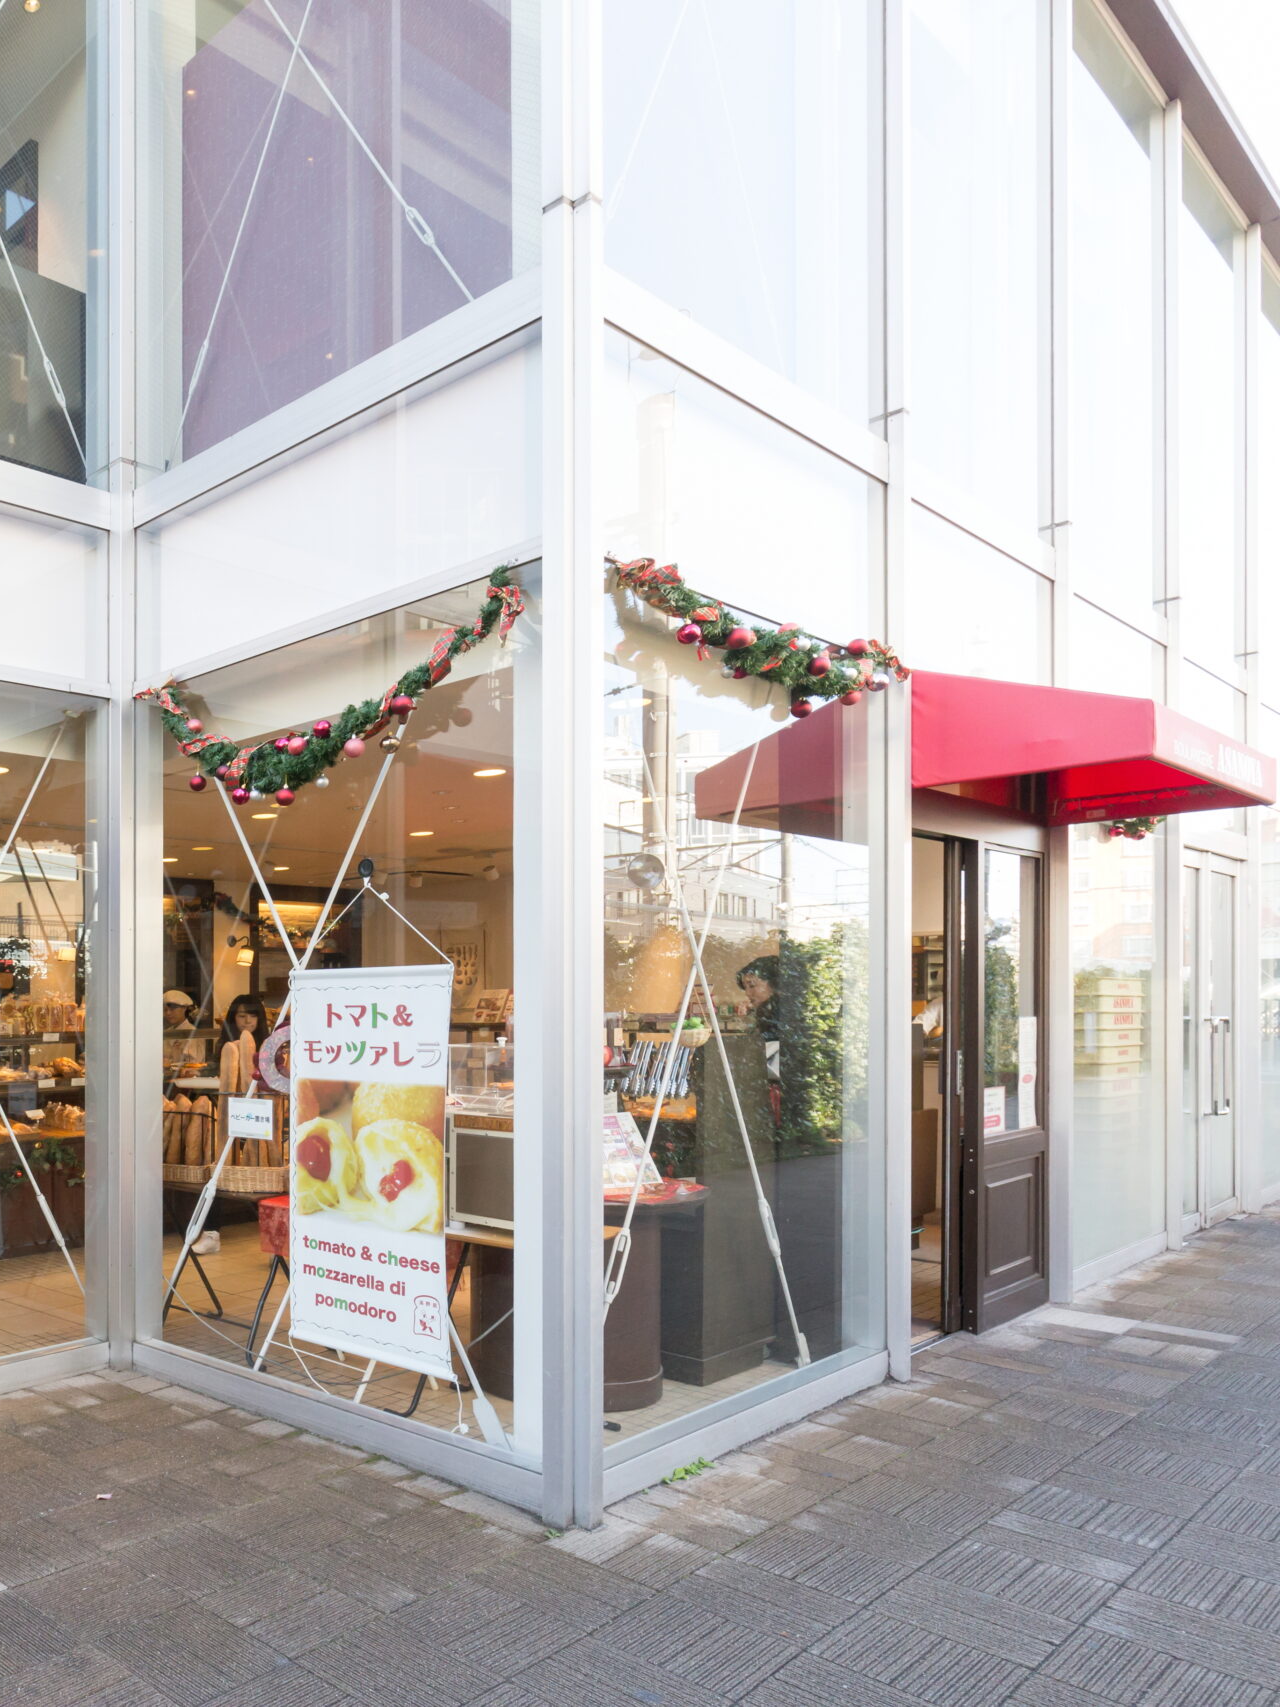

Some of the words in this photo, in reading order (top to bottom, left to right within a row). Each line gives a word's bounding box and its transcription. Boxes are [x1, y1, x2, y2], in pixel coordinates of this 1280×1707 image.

[325, 1002, 414, 1029] トマト&
[303, 1040, 442, 1069] モッツァレラ
[302, 1234, 357, 1260] tomato
[360, 1245, 373, 1262] &
[377, 1250, 441, 1275] cheese
[302, 1264, 386, 1293] mozzarella
[389, 1280, 407, 1298] di
[314, 1292, 399, 1324] pomodoro
